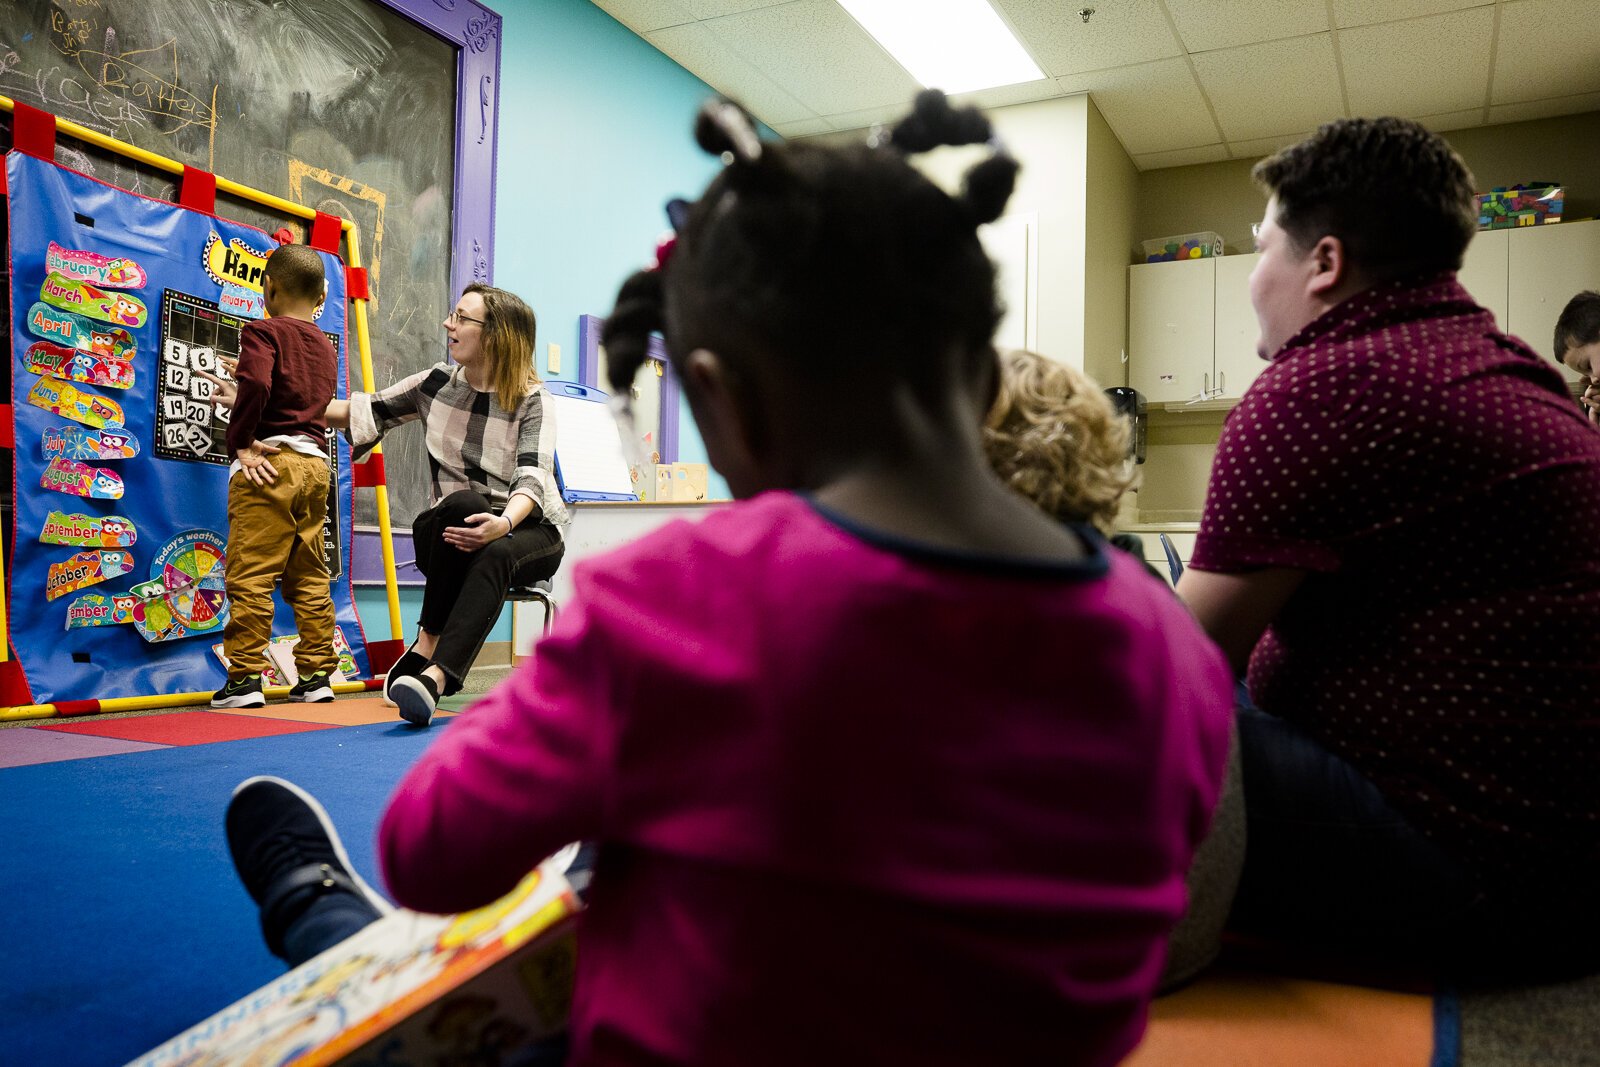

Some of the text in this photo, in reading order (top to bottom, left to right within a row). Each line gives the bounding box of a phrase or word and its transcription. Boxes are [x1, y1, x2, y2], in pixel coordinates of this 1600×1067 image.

[44, 279, 83, 304] March
[220, 293, 254, 312] anuary
[33, 311, 72, 338] April
[31, 350, 64, 371] May
[172, 345, 208, 368] 5 6
[33, 382, 60, 404] June
[171, 369, 210, 398] 12 13
[170, 400, 184, 416] 19
[187, 405, 205, 422] 20
[45, 434, 67, 455] July
[167, 427, 209, 451] 26 27
[44, 521, 99, 539] eptember
[154, 532, 225, 567] Today's weather
[70, 603, 109, 619] ember
